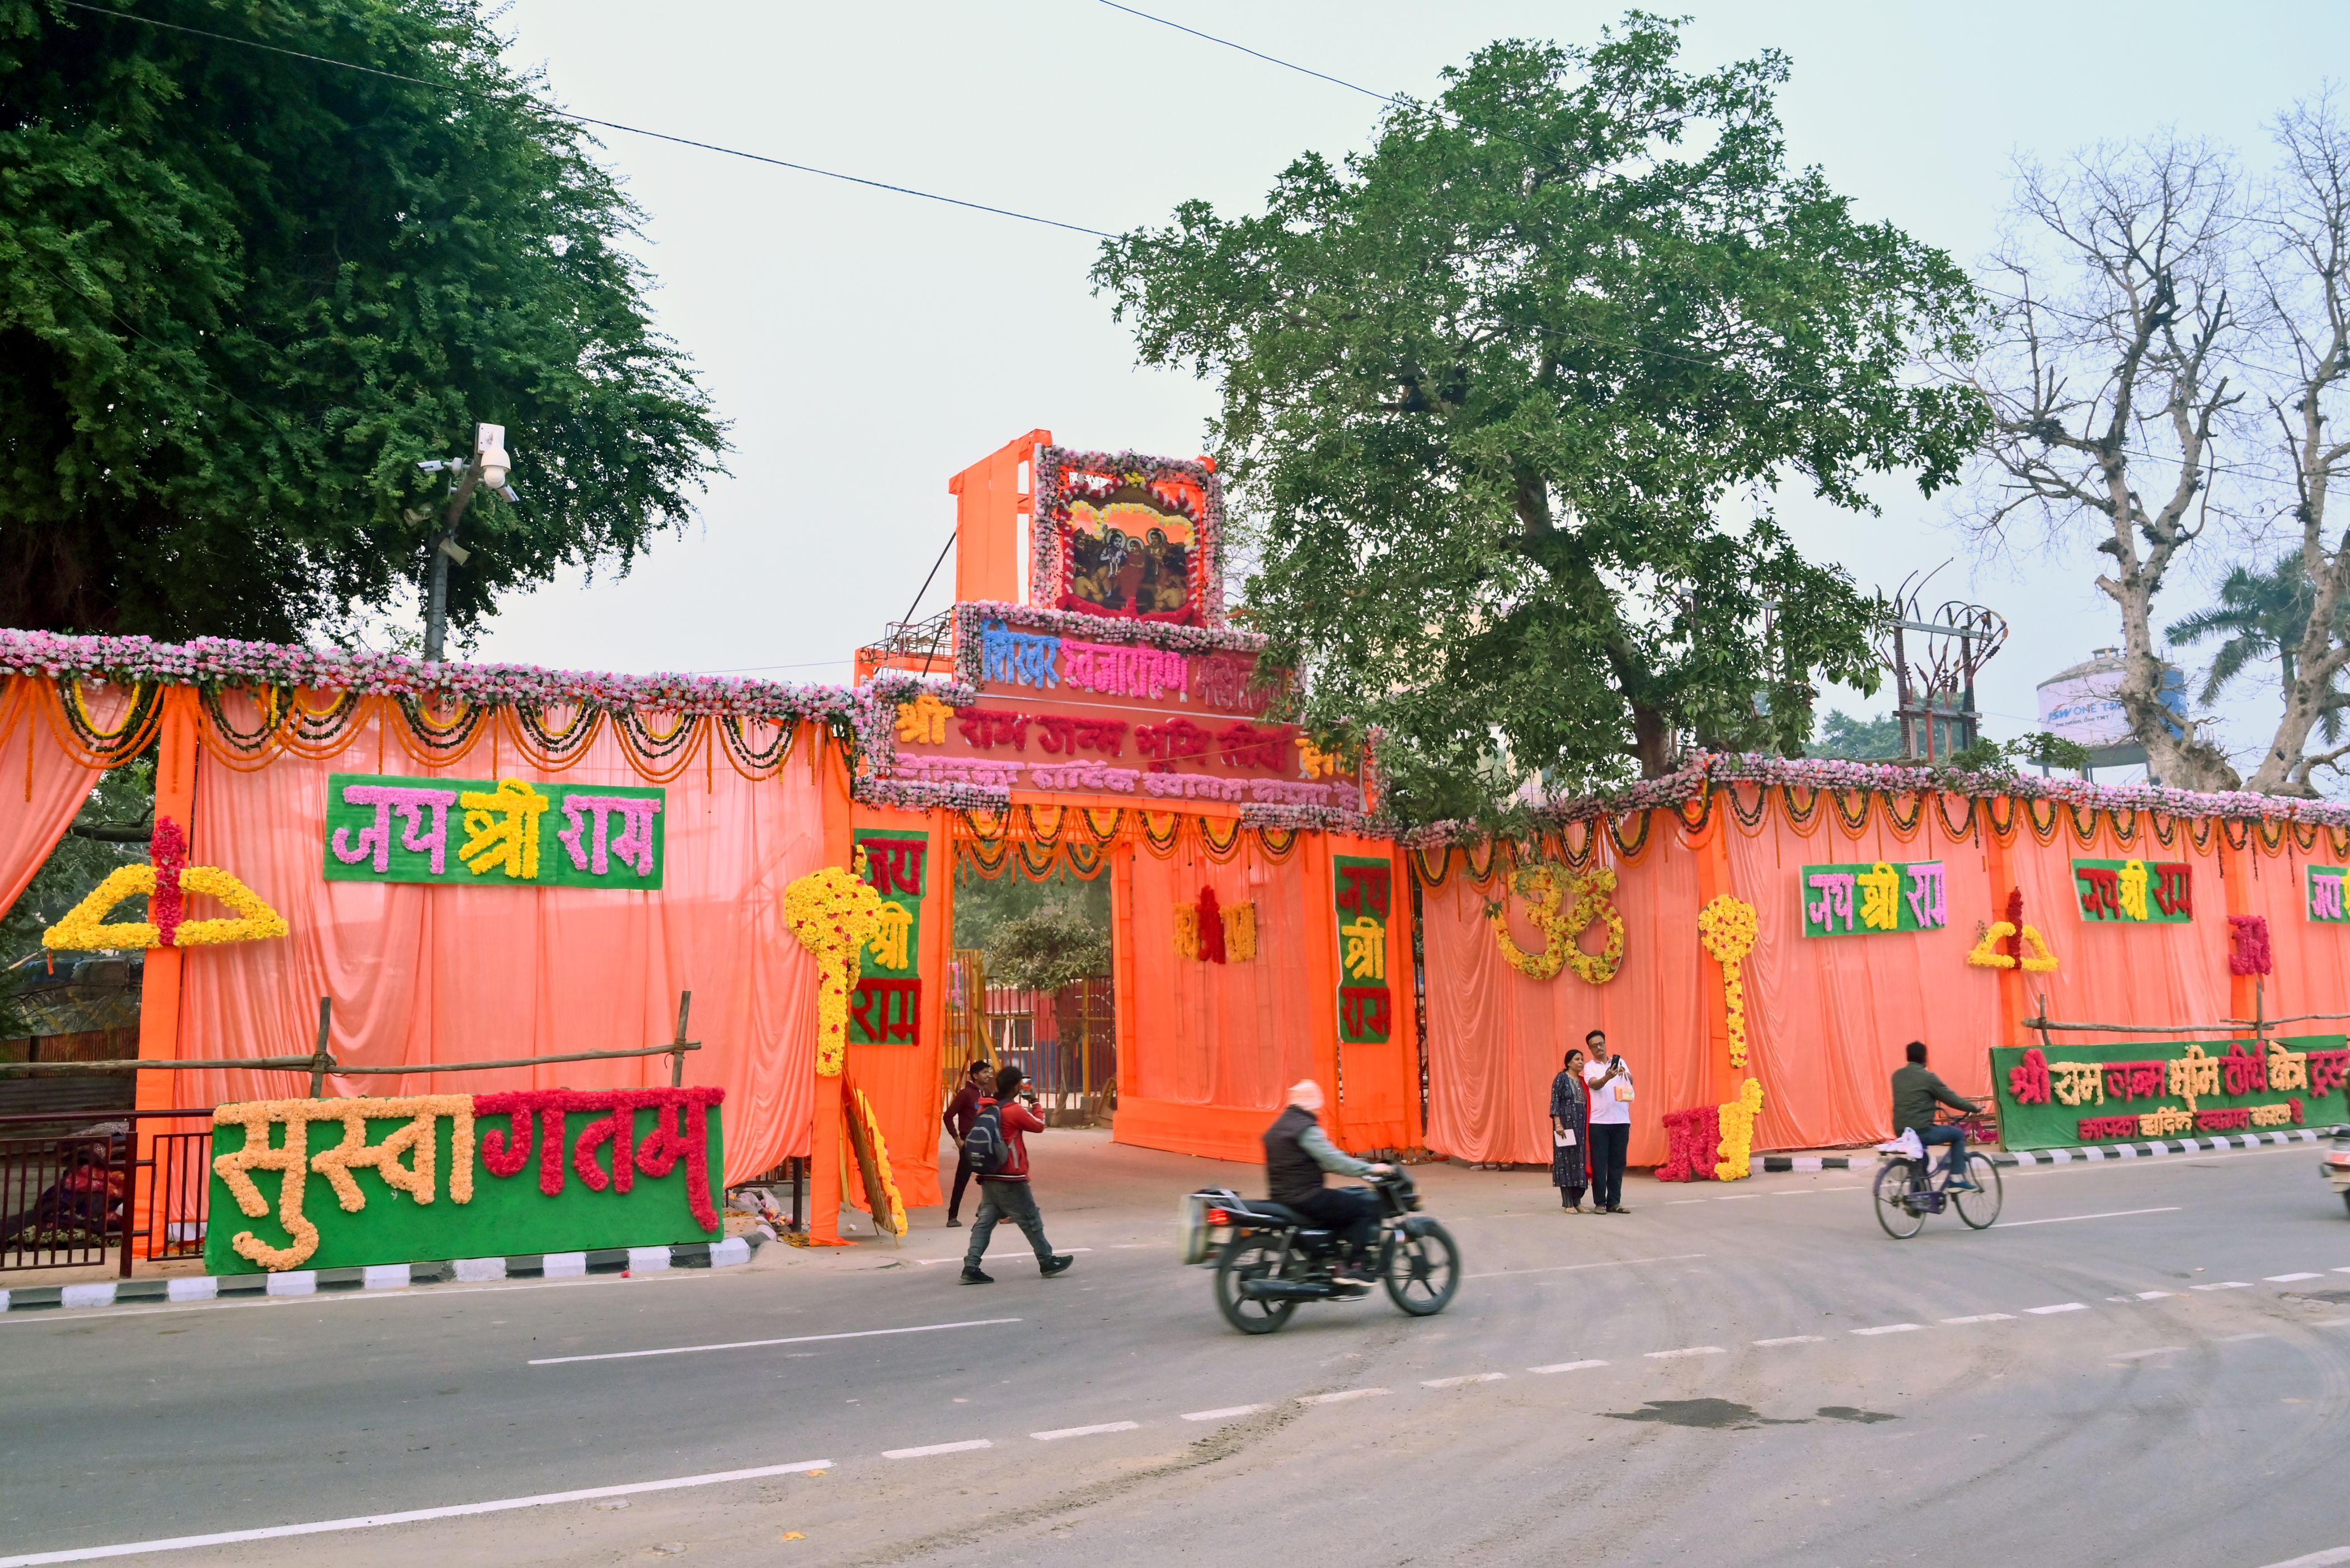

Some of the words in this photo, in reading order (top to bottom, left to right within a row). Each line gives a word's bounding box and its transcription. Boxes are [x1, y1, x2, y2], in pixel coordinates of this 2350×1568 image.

[979, 618, 1061, 689] शिखर
[895, 694, 954, 745] श्री
[953, 706, 1033, 751] राम
[1035, 714, 1129, 757] जन्म
[1134, 718, 1213, 774] भूमि
[2074, 703, 2097, 715] ONE
[332, 785, 457, 874] जय
[458, 778, 549, 879] श्री
[557, 793, 661, 877] राम
[858, 837, 928, 895] जय
[1338, 866, 1391, 919] जय
[1808, 873, 1855, 931] जय
[1856, 860, 1899, 930] श्री
[1905, 863, 1947, 927] राम
[2077, 868, 2121, 920] जय
[2118, 859, 2148, 921] श्री
[2153, 863, 2193, 921] राम
[2311, 874, 2342, 920] जय
[868, 901, 913, 970] श्री
[1341, 916, 1385, 980] श्री
[850, 978, 923, 1047] राम
[1341, 986, 1392, 1038] राम
[2010, 1048, 2051, 1104] श्री
[2048, 1062, 2104, 1106] राम
[2169, 1045, 2220, 1113] भूमि
[2219, 1042, 2268, 1096] तीर्थ
[2078, 1115, 2140, 1141] आपका
[2139, 1106, 2193, 1136] हार्दिक
